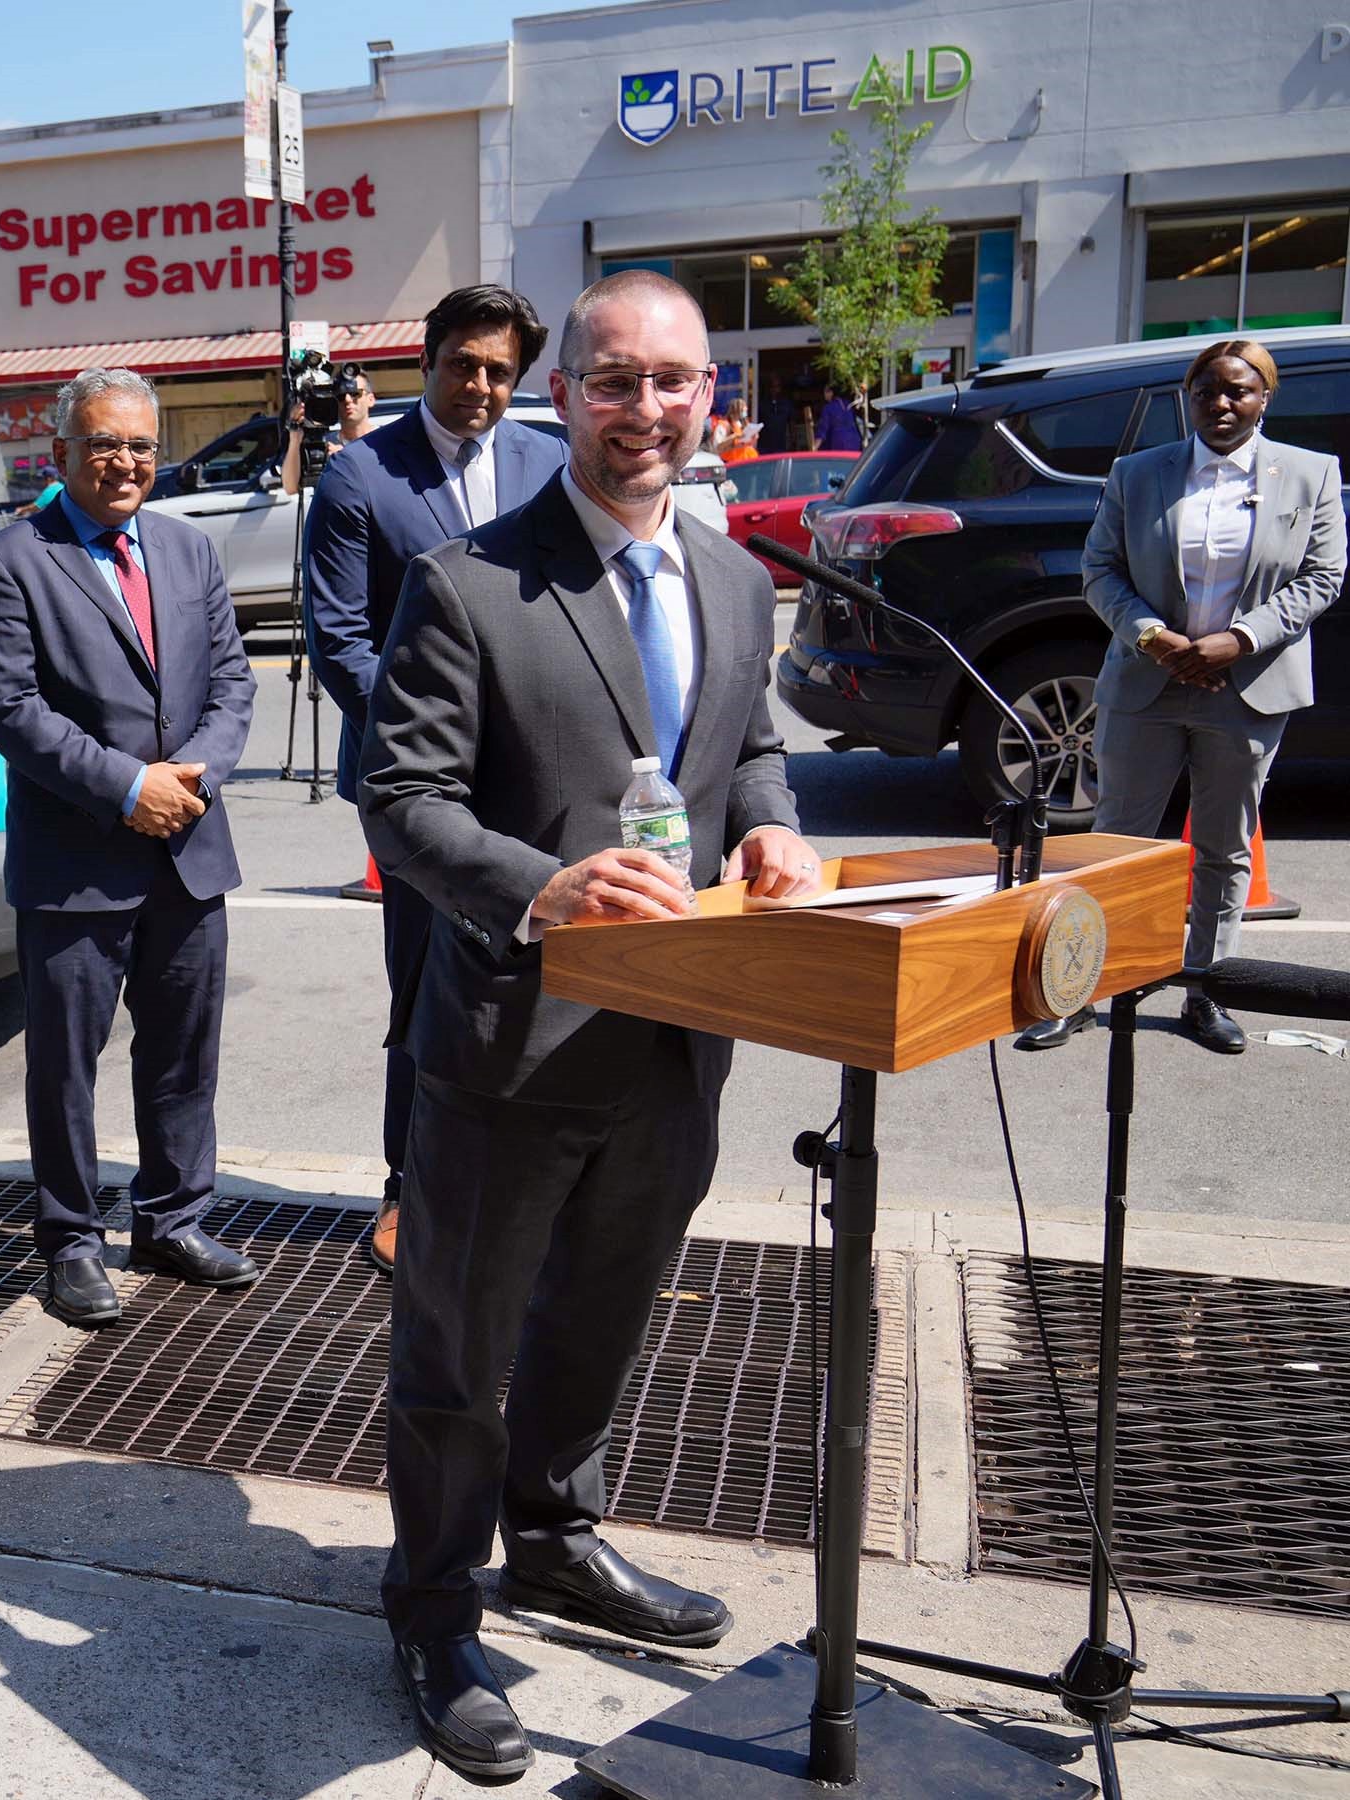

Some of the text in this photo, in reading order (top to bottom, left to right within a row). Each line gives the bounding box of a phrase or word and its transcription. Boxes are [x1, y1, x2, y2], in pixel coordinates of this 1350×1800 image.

[687, 45, 972, 127] RITE AID
[284, 134, 299, 165] 25
[18, 246, 354, 307] For Savings
